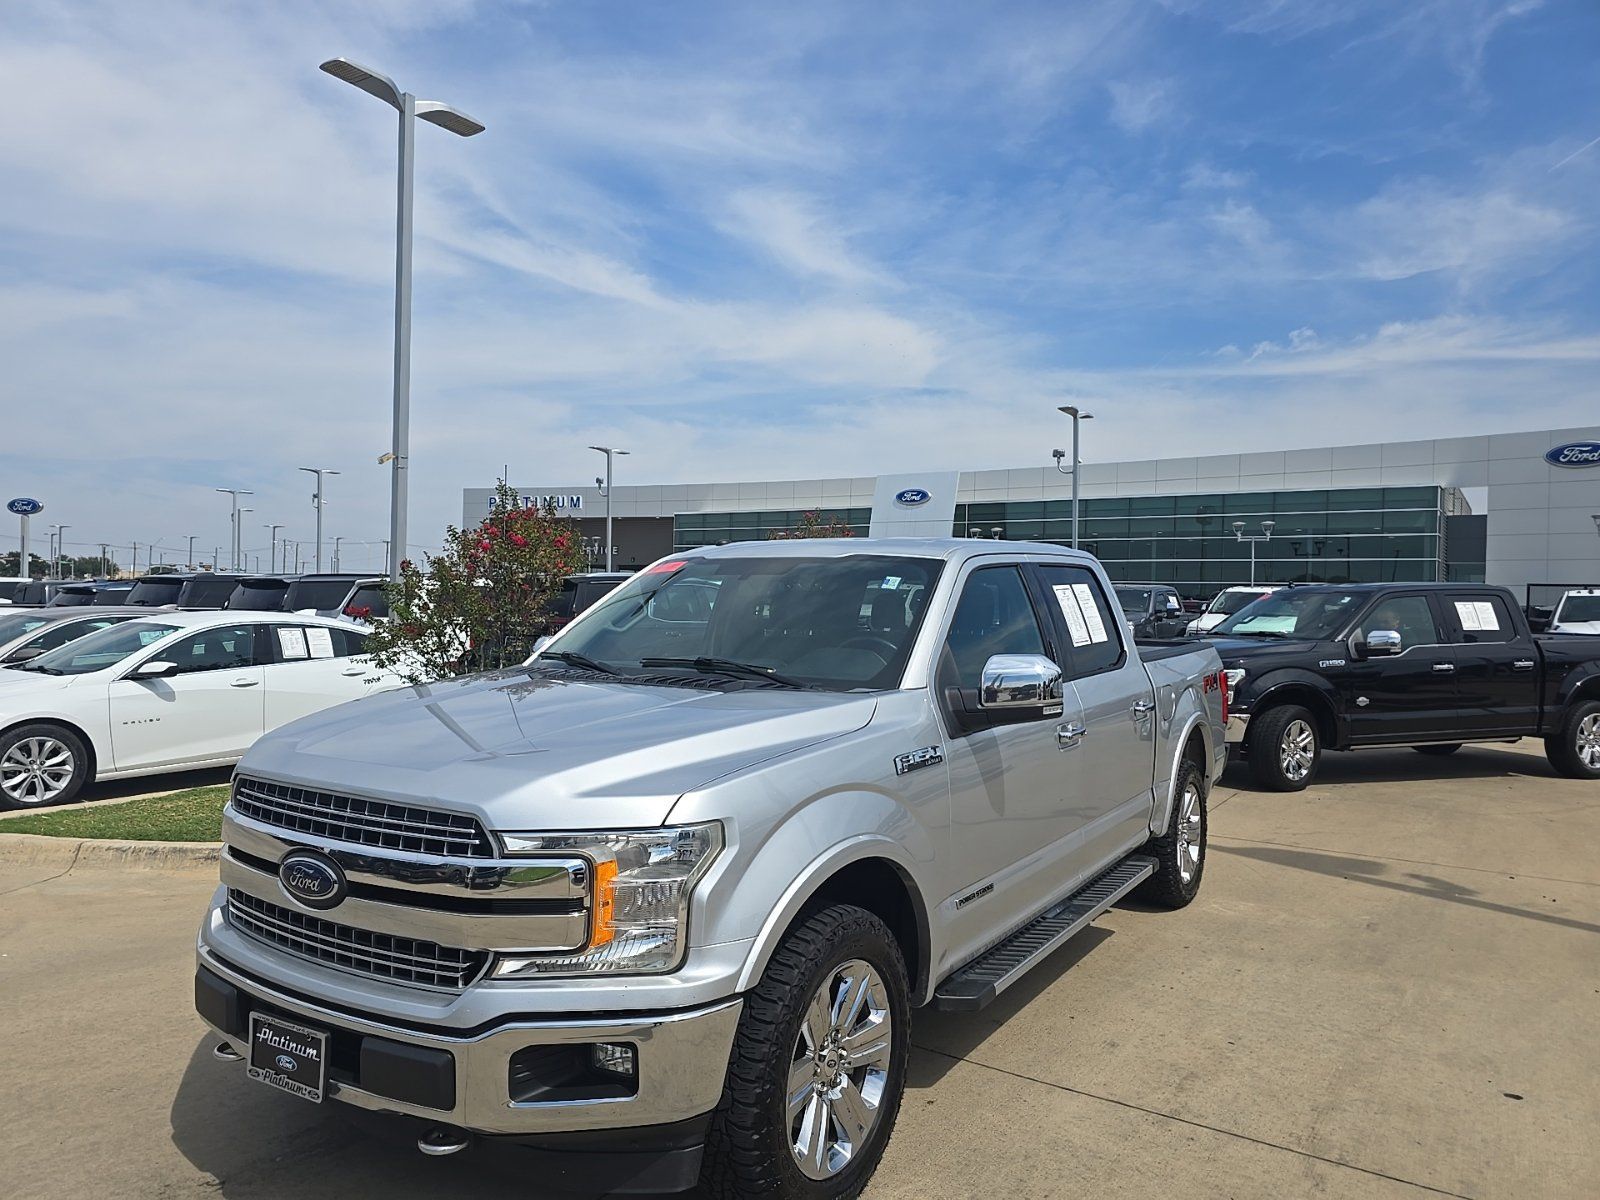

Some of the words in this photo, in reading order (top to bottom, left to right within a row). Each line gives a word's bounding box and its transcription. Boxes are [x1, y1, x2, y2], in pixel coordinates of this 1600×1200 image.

[1559, 446, 1600, 462] Ford
[488, 496, 581, 509] PATINUM
[901, 491, 922, 501] Ford
[12, 501, 33, 511] Ford
[122, 717, 161, 725] MALIBU
[289, 865, 322, 892] Ford
[256, 1027, 321, 1062] Platinum
[279, 1058, 294, 1070] Ford
[262, 1069, 307, 1096] Platinum
